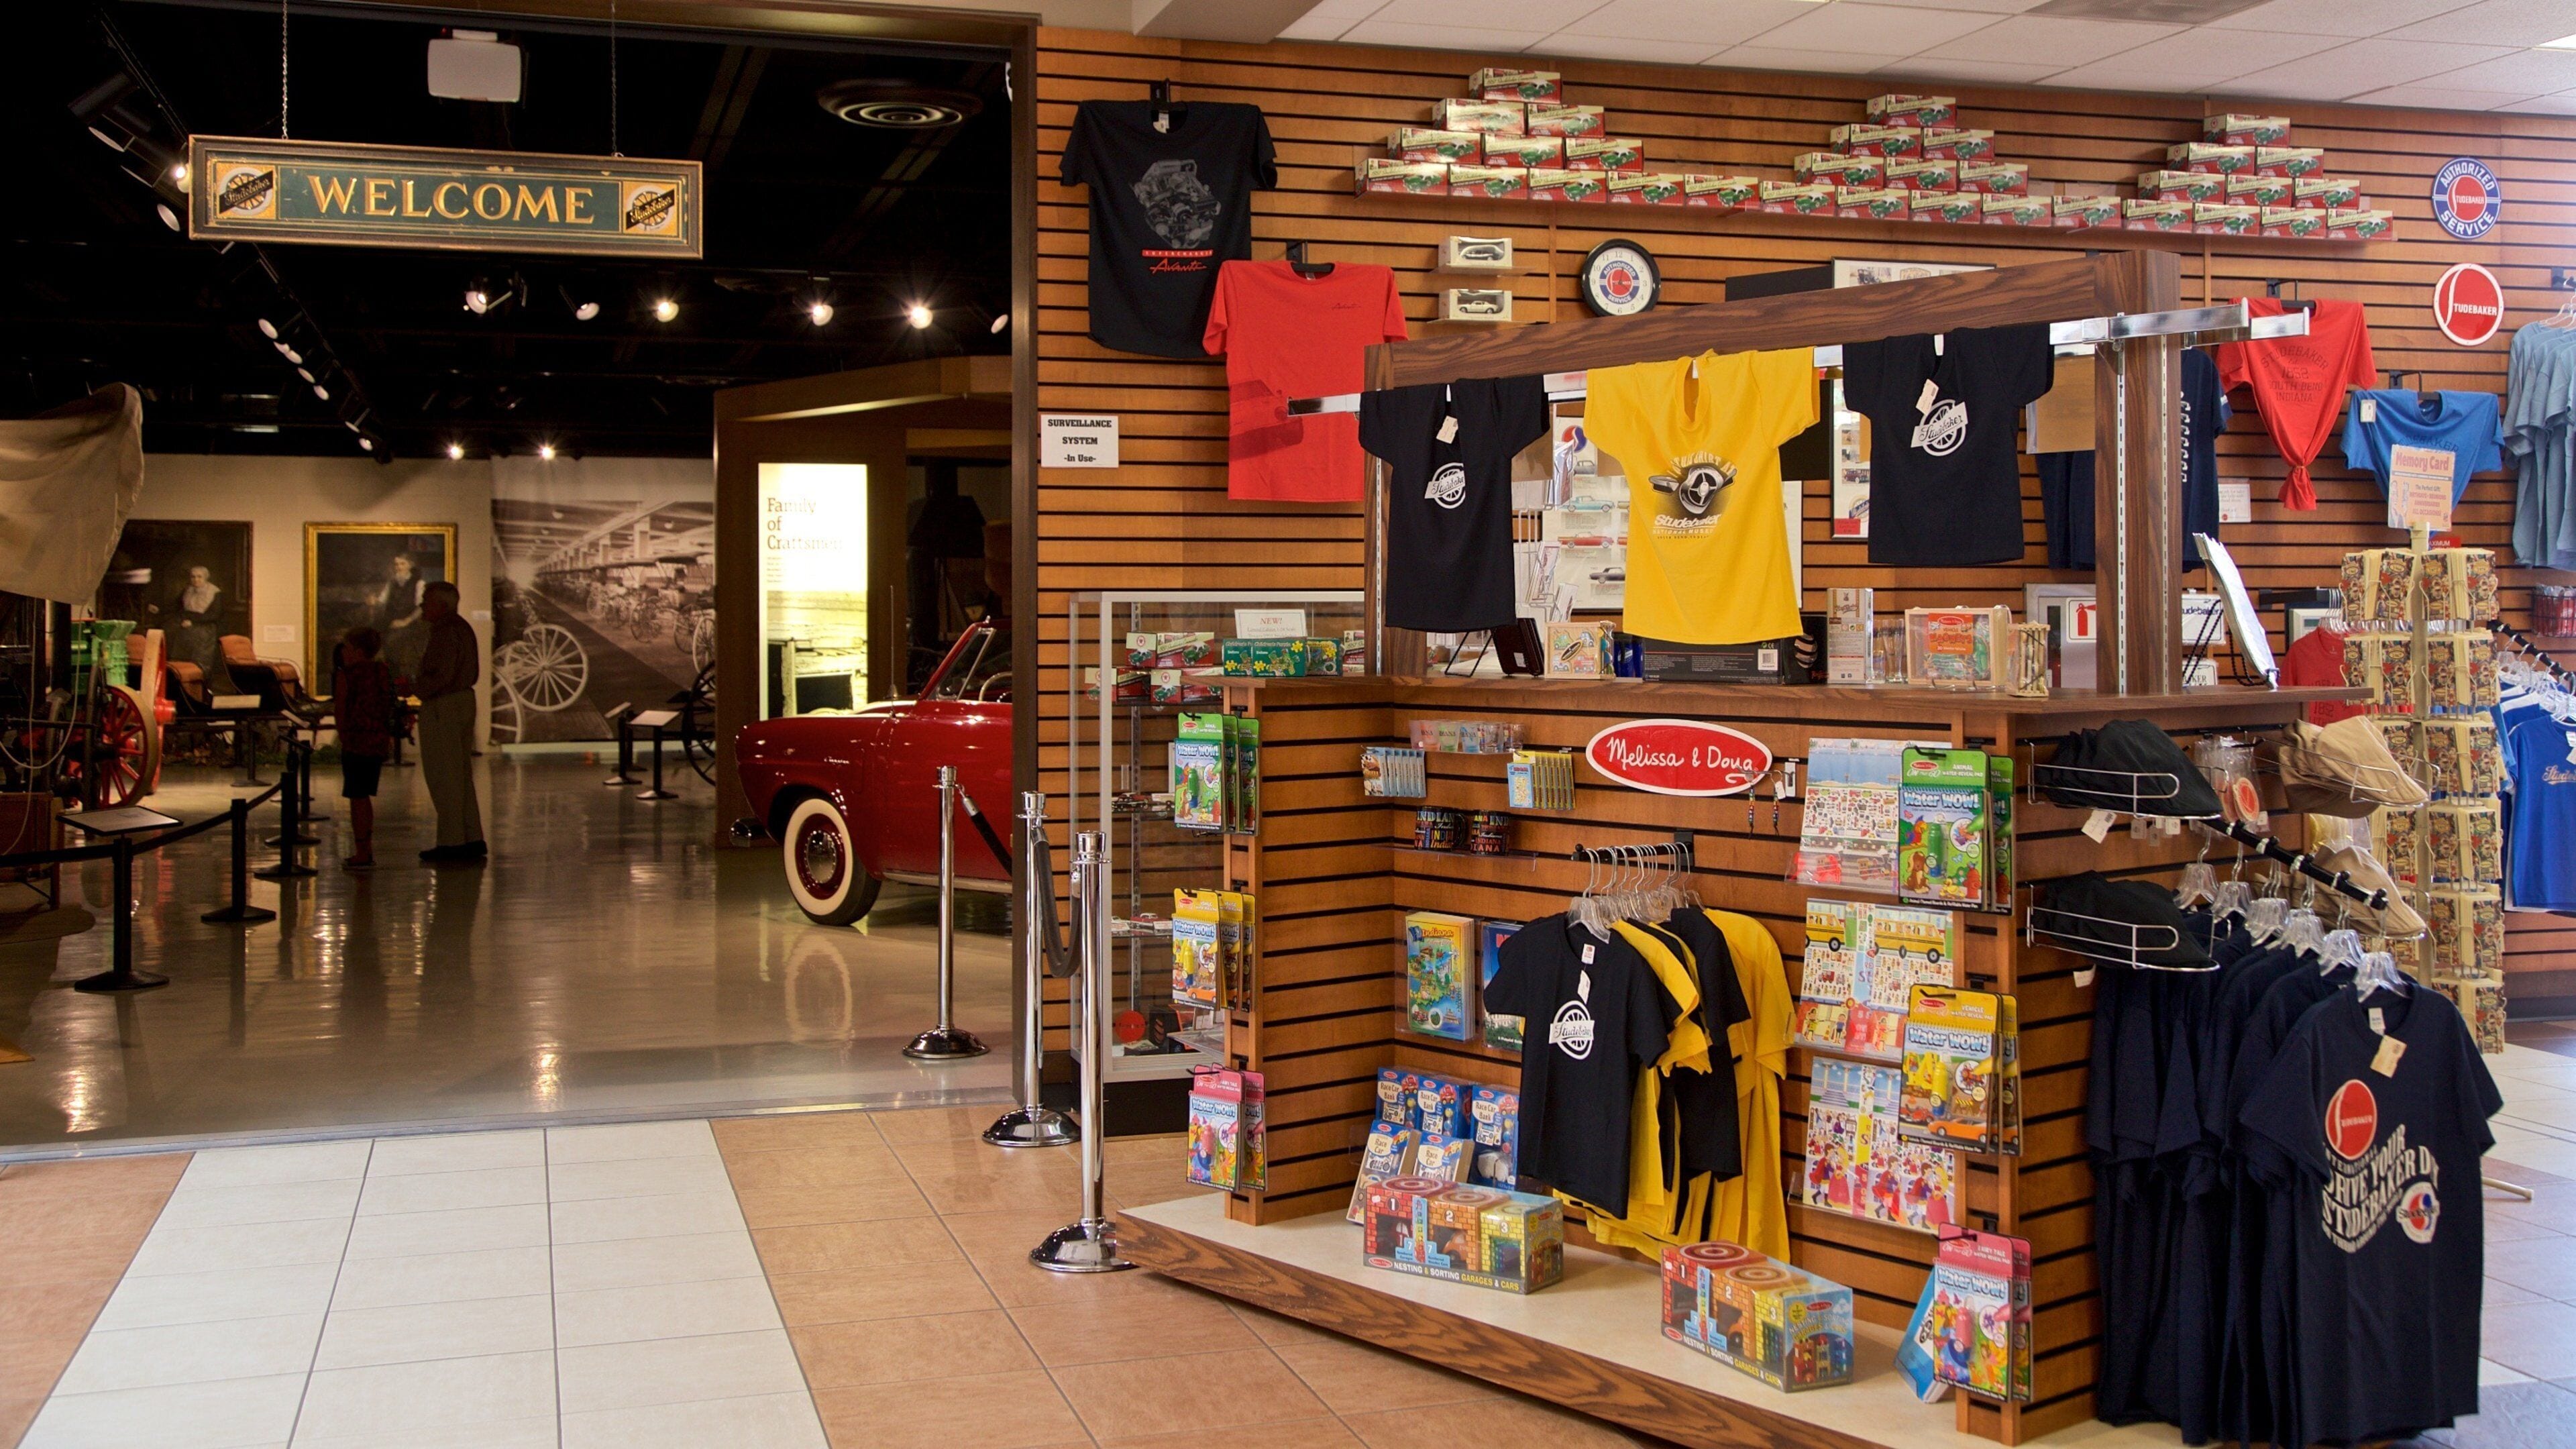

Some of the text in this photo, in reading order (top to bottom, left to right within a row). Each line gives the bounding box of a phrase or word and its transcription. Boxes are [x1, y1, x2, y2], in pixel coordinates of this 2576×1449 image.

[2440, 162, 2495, 191] AUTHORIZED
[223, 176, 270, 205] Studebaker
[309, 176, 596, 224] WELCOME
[630, 193, 674, 222] Studebaker
[2440, 211, 2494, 235] SERVICE
[1149, 258, 1208, 274] Avanti
[1603, 262, 1636, 276] AUTHORIZED
[1608, 294, 1632, 304] SERVICE
[2261, 345, 2328, 370] STUDEBAKER
[2282, 367, 2308, 379] 1852
[2301, 382, 2323, 391] BEND
[2276, 392, 2313, 402] INDIANA
[1048, 419, 1112, 428] SURVEILLANCE
[1919, 415, 1964, 441] Studebaker
[1062, 437, 1098, 445] SYSTEM
[1064, 454, 1096, 463] -In Use-
[2396, 451, 2449, 472] Memory Card
[1431, 477, 1464, 494] Studebake
[767, 496, 816, 515] Family
[767, 517, 782, 531] of
[1654, 513, 1722, 529] Studebaker
[767, 534, 843, 550] Craftsmen
[2182, 606, 2219, 615] udebaker
[1260, 617, 1283, 625] NEW!
[1177, 745, 1219, 757] Water WOW!
[1607, 737, 1684, 770] Melissa
[1692, 747, 1701, 768] &
[1903, 791, 1980, 810] Water WOW!
[1175, 920, 1215, 938] Water WOW!
[1221, 924, 1238, 938] OW!
[1422, 927, 1454, 937] Indiana
[1961, 1005, 1984, 1013] VEHICLE
[1554, 1022, 1593, 1039] Studebaker
[1909, 1027, 1988, 1053] Water WOW!
[1381, 1082, 1399, 1092] Race Car
[1384, 1092, 1395, 1100] Bank
[1420, 1091, 1430, 1100] Race
[1191, 1098, 1235, 1118] Water WOW!
[1424, 1101, 1434, 1110] Bank
[1475, 1102, 1497, 1112] Race Car
[1479, 1112, 1491, 1121] Bank
[1375, 1138, 1387, 1146] Race
[1375, 1146, 1384, 1155] Car
[1426, 1150, 1438, 1159] Race
[1426, 1159, 1435, 1167] Car
[1390, 1198, 1396, 1211] 1
[1446, 1211, 1454, 1222] 2
[1500, 1222, 1509, 1233] 3
[1407, 1241, 1413, 1250] 7
[1427, 1244, 1433, 1253] 7
[1393, 1261, 1423, 1274] NESTING
[1430, 1268, 1460, 1280] SORTING
[1461, 1273, 1493, 1286] GARAGES
[1500, 1280, 1519, 1291] CARS
[1680, 1265, 1685, 1279] 1
[1937, 1267, 2006, 1299] Water WOW!
[1725, 1286, 1731, 1299] 2
[1770, 1307, 1776, 1320] 3
[1682, 1336, 1706, 1352] NESTING
[1711, 1346, 1733, 1365] SORTING
[1734, 1359, 1760, 1376] GARAGES
[1765, 1373, 1780, 1386] CARS
